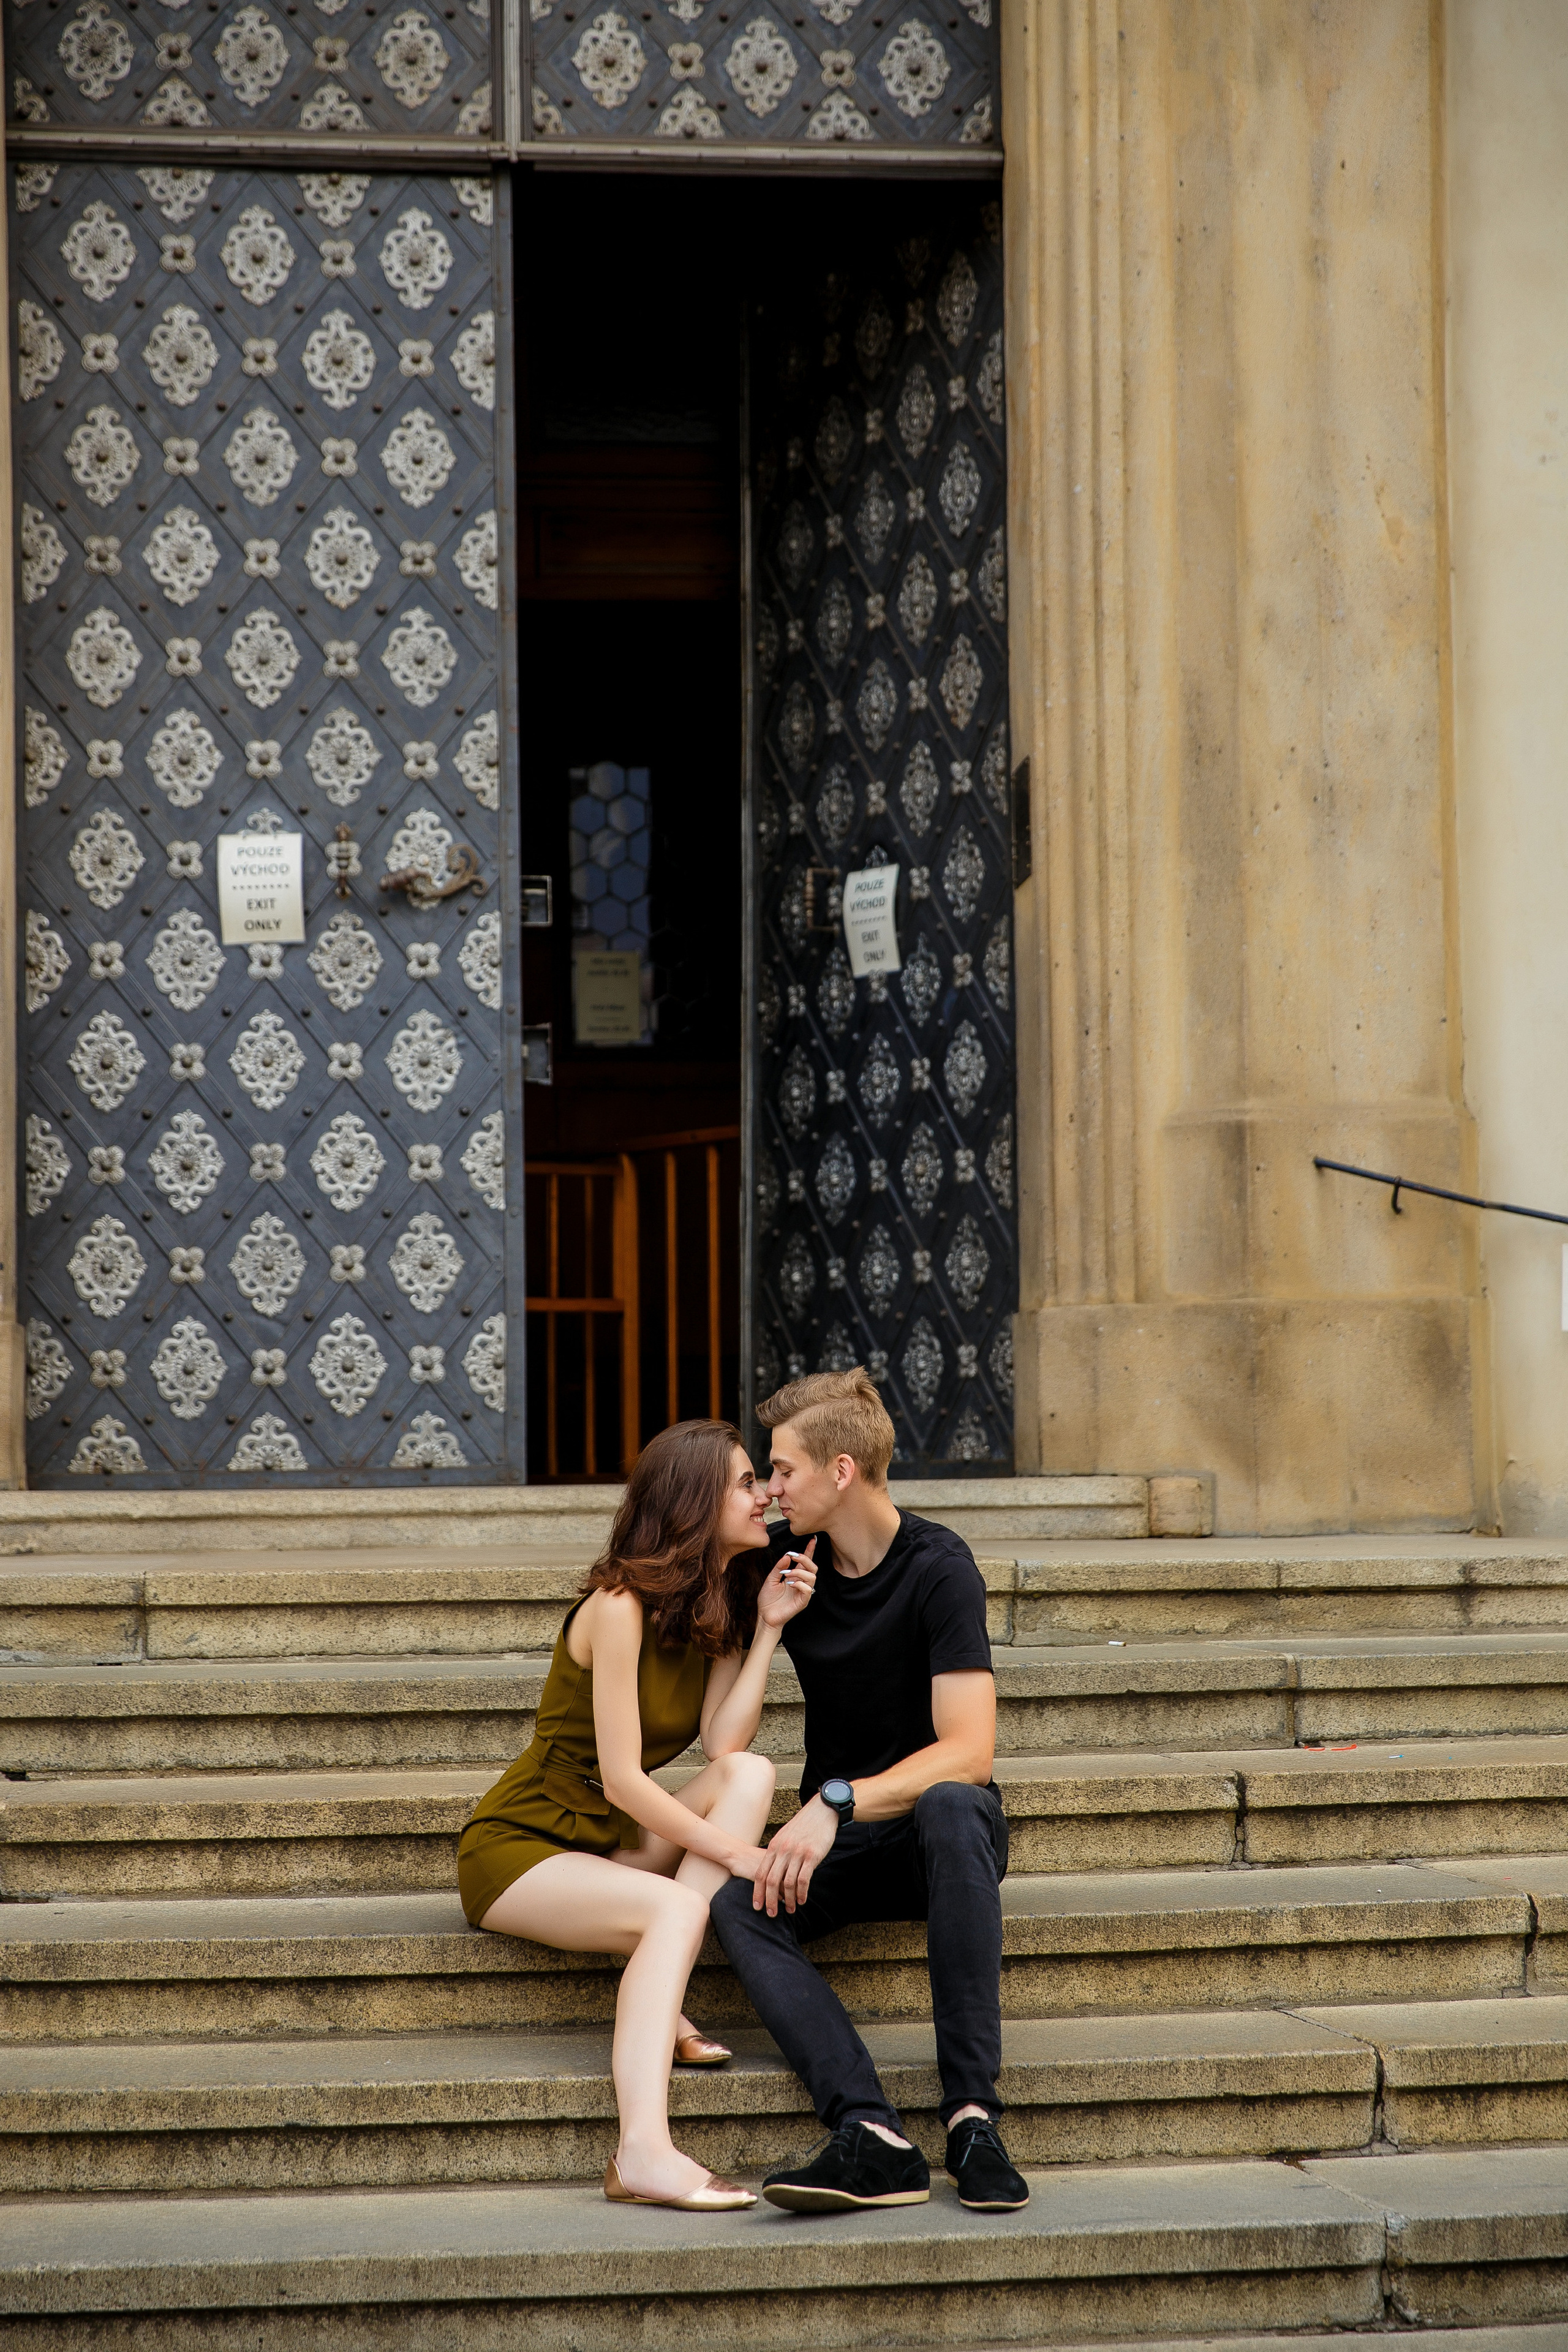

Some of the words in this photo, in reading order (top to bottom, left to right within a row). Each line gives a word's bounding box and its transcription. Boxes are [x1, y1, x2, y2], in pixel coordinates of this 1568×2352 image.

[237, 846, 284, 856] POUZE
[230, 862, 290, 875] VÝCHOD
[246, 898, 276, 910] EXIT
[244, 919, 282, 932] ONLY
[861, 930, 880, 943] EXIT
[863, 949, 885, 963] ONLY
